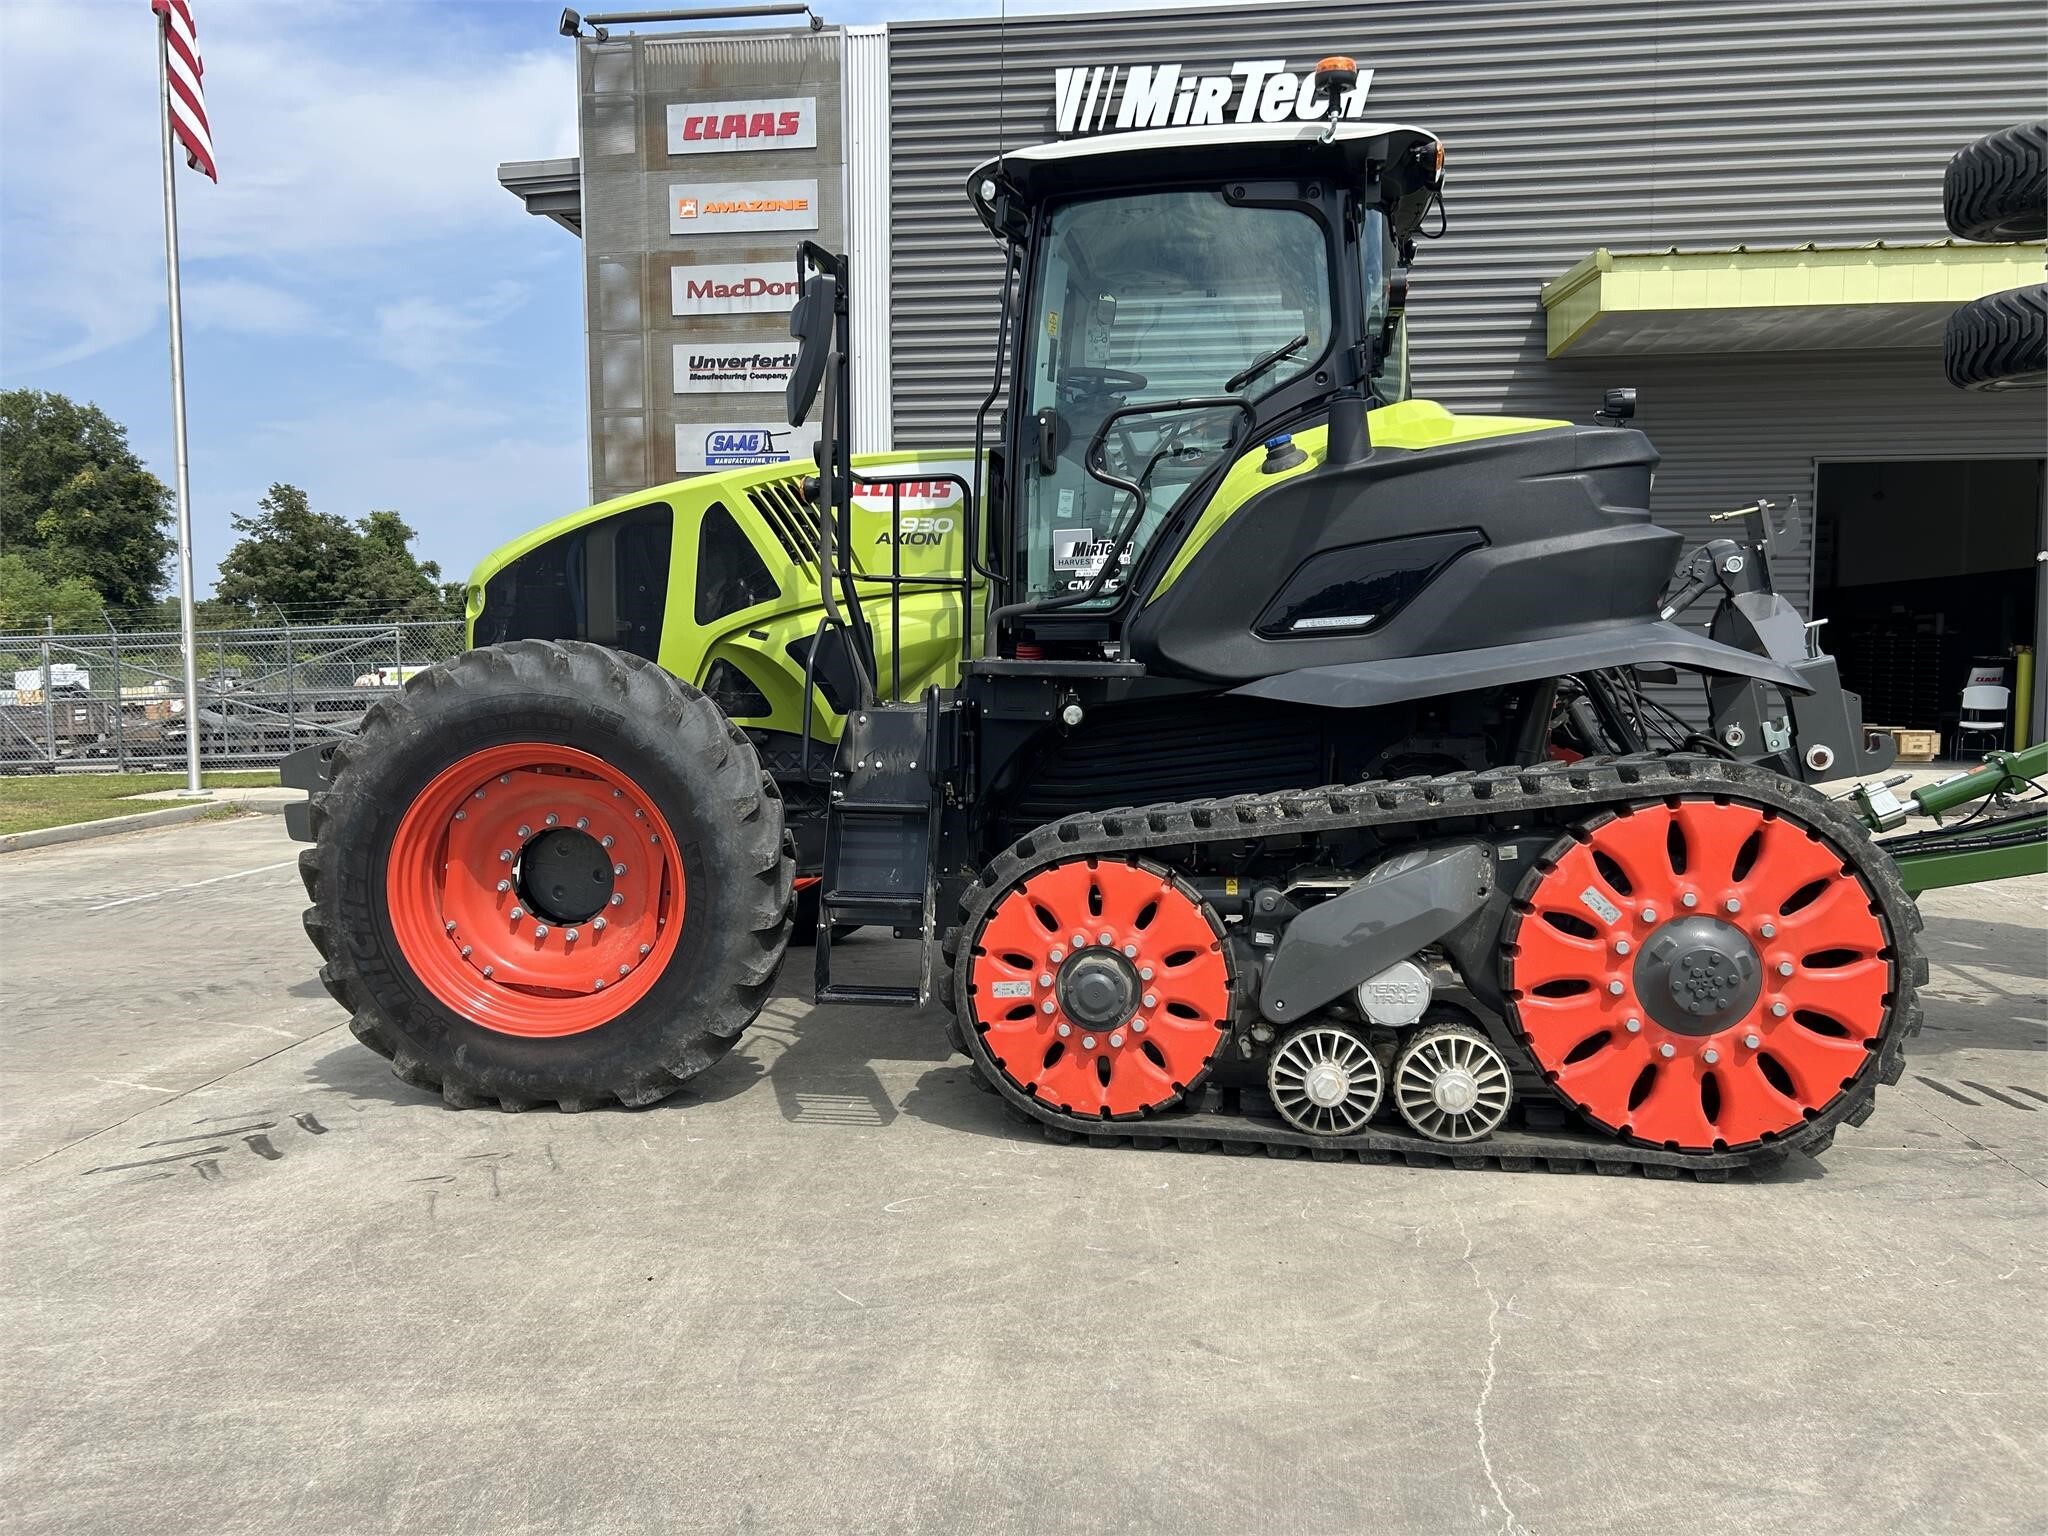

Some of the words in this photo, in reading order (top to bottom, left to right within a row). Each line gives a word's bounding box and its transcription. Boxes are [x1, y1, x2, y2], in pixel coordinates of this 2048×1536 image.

[683, 112, 800, 140] CLAAS
[703, 200, 808, 213] AMAZONE
[687, 278, 800, 298] MacDon
[689, 373, 747, 381] Manufacturing
[750, 372, 788, 381] Company,
[714, 457, 767, 465] MANUFACTURING,
[900, 517, 954, 533] 930
[875, 532, 943, 545] AXION
[1058, 558, 1094, 566] HARVEST
[1068, 579, 1119, 590] CMIC
[1368, 982, 1421, 994] TERRA
[1374, 993, 1418, 1005] TRAC
